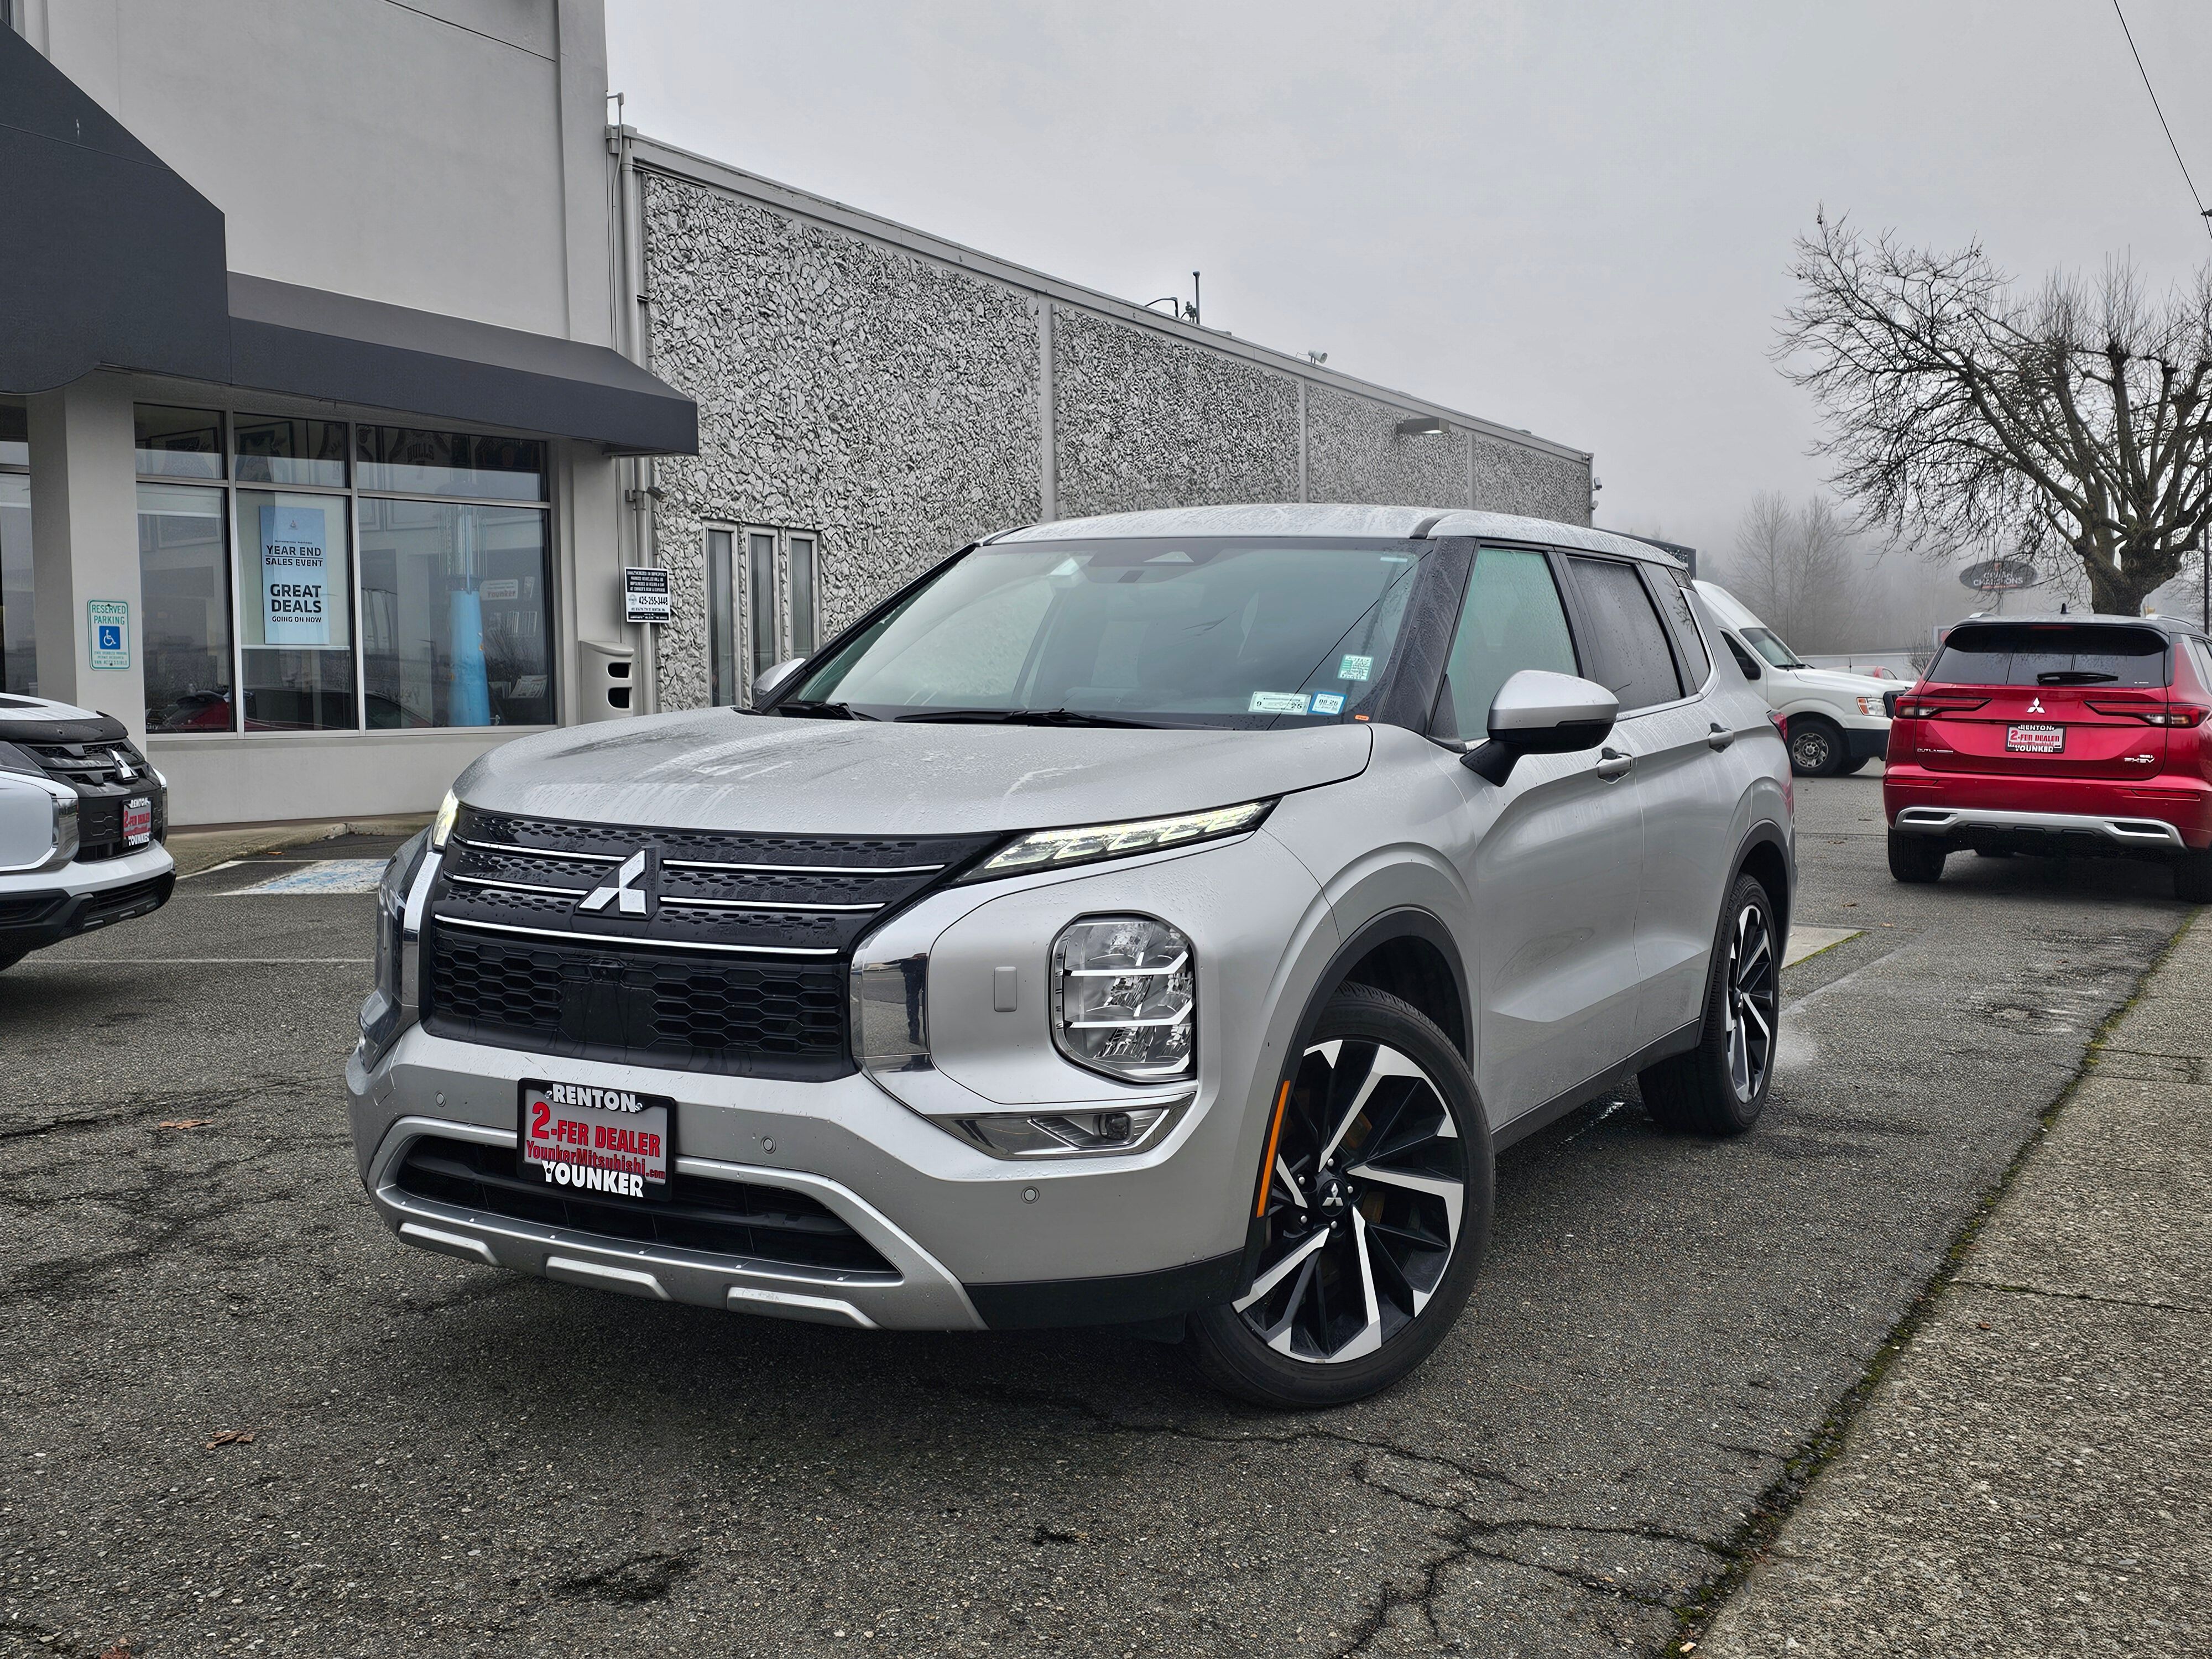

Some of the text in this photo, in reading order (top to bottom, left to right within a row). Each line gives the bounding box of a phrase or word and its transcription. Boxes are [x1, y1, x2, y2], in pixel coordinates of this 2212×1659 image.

[408, 443, 434, 462] BULLS
[266, 545, 321, 556] YEAR END
[265, 557, 323, 567] SALES EVENT
[270, 583, 321, 598] GREAT
[91, 604, 126, 614] RESERVED
[271, 599, 321, 613] DEALS
[93, 615, 125, 625] PARKING
[2015, 744, 2054, 753] YOUNKER
[553, 1084, 636, 1113] RENTON
[531, 1102, 660, 1157] 2-FER DEALER
[526, 1140, 665, 1180] YounkerMitsubishi.com
[541, 1160, 644, 1198] YOUNKER
